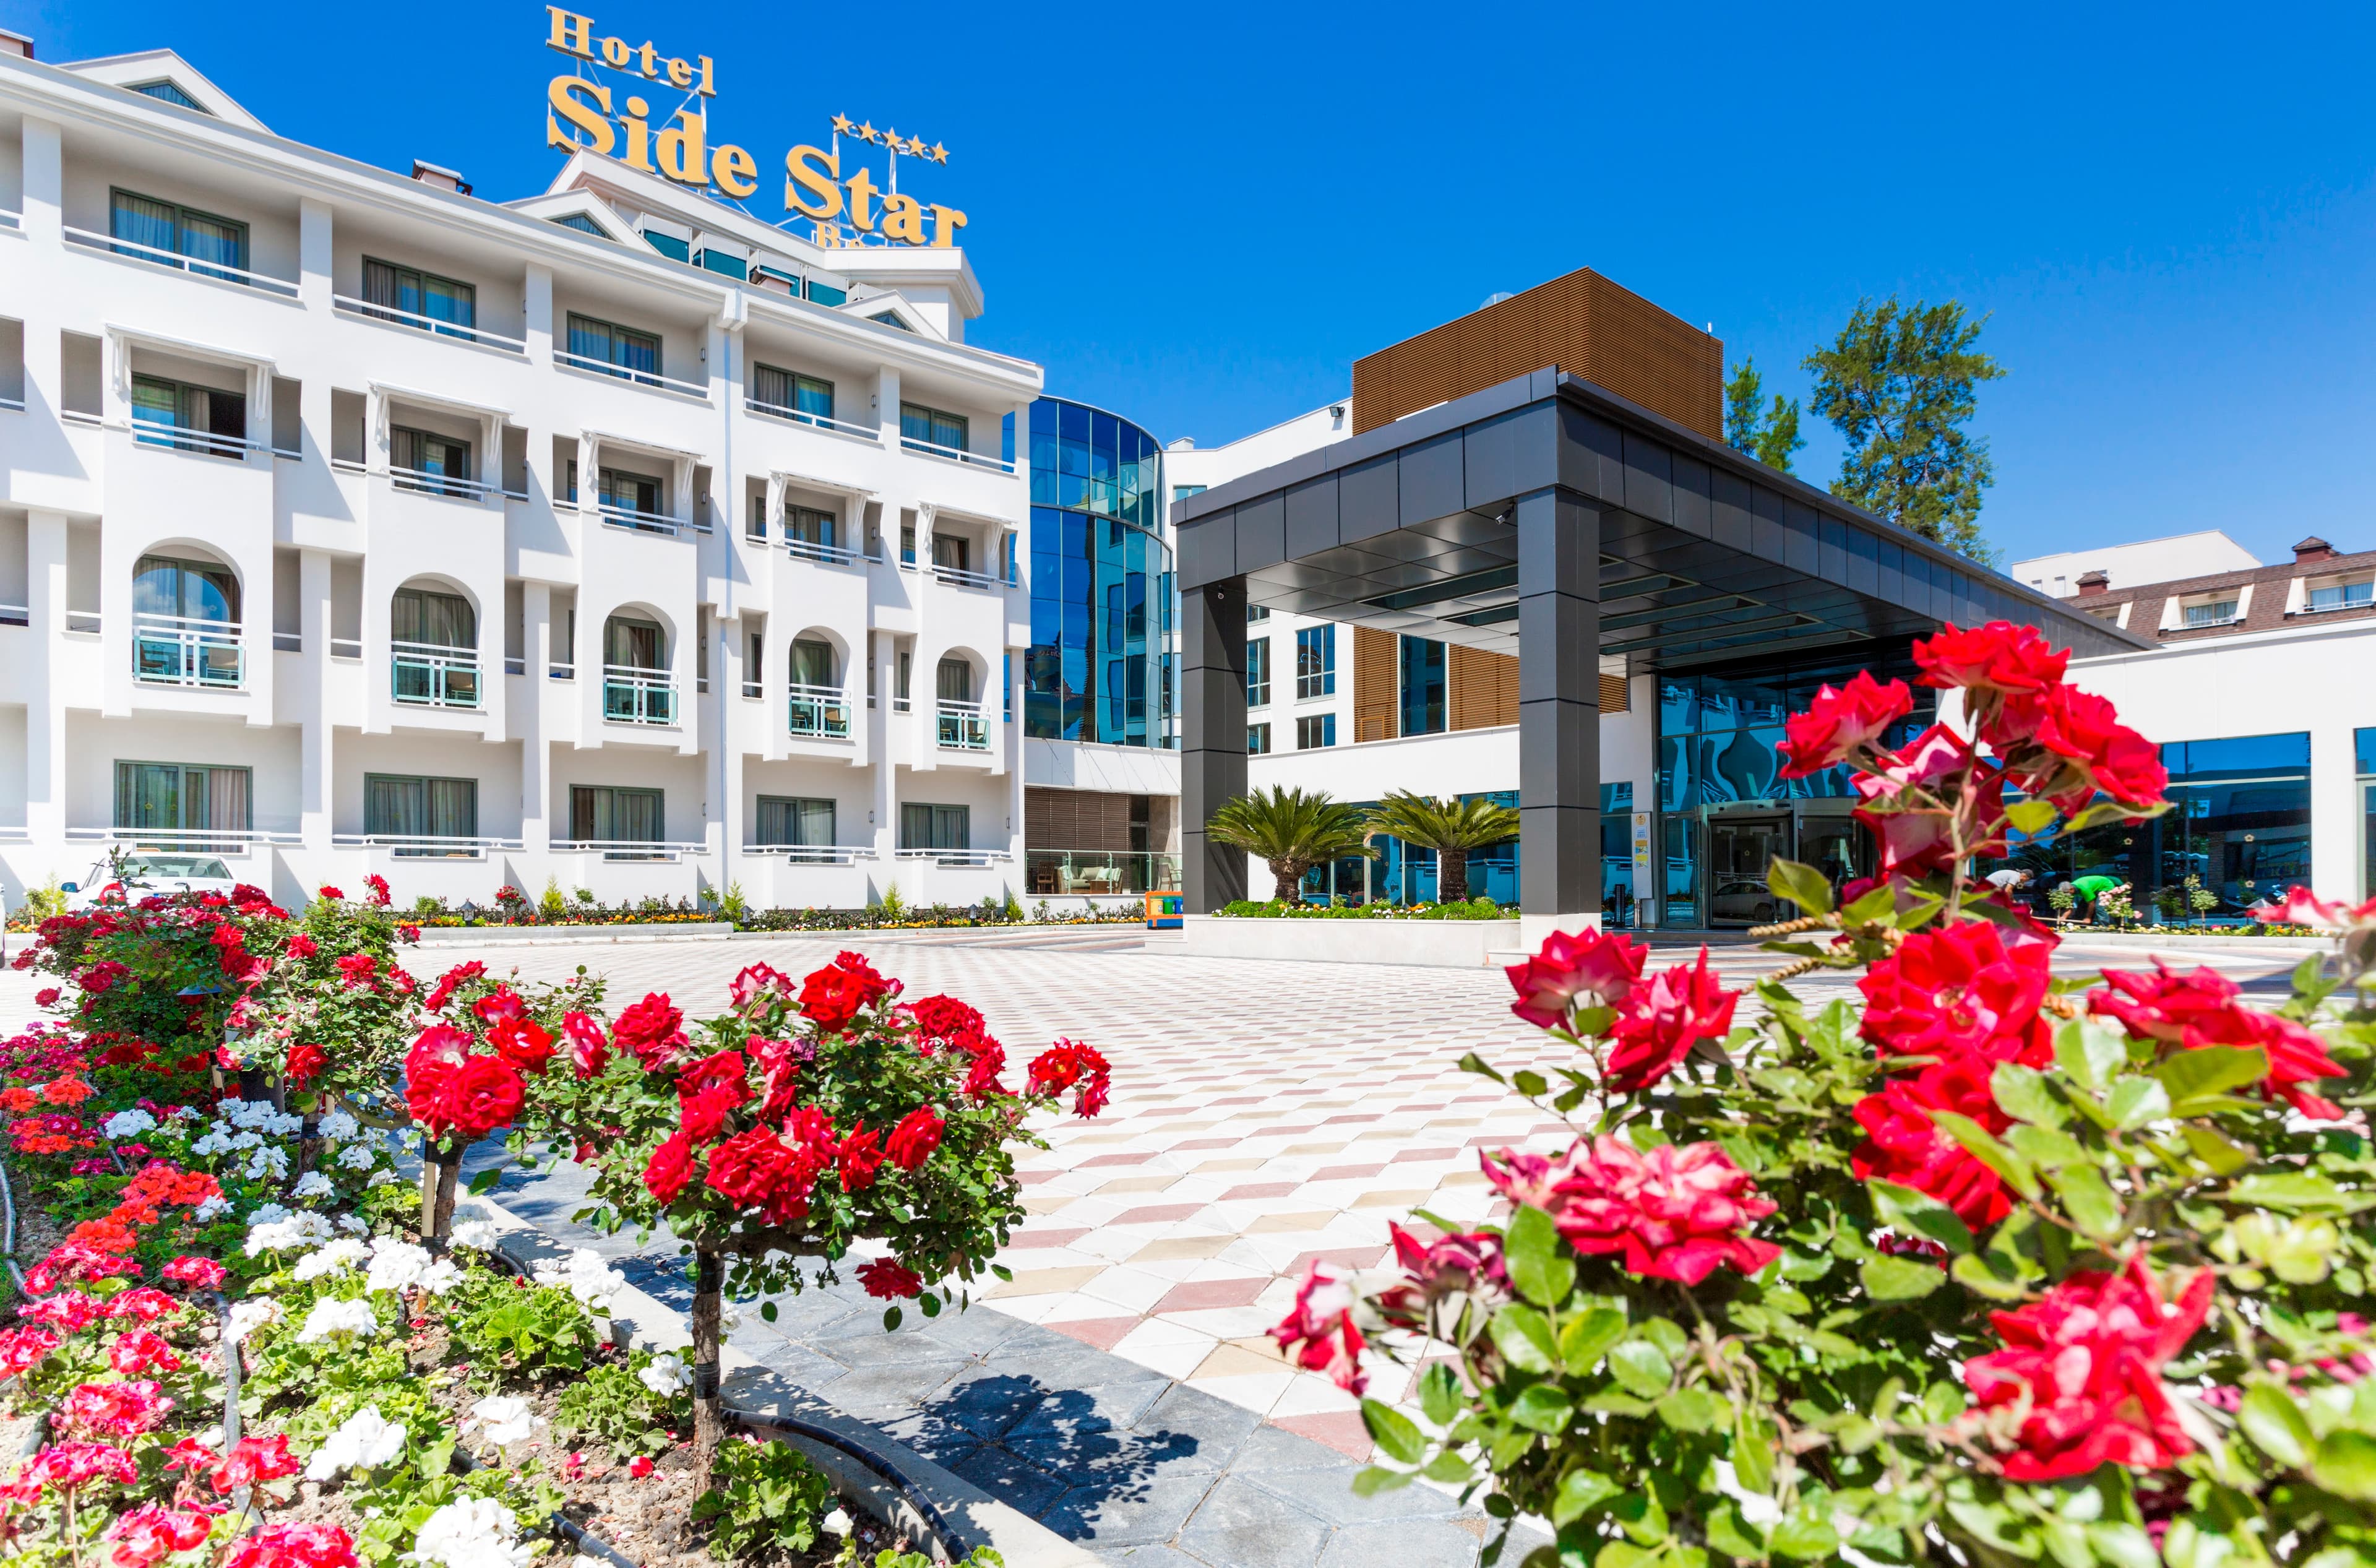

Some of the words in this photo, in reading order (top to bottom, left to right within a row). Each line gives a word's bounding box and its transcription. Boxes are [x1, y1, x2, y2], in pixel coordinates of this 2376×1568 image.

[546, 5, 717, 98] Hotel
[548, 75, 759, 200] Side
[785, 144, 968, 248] Star
